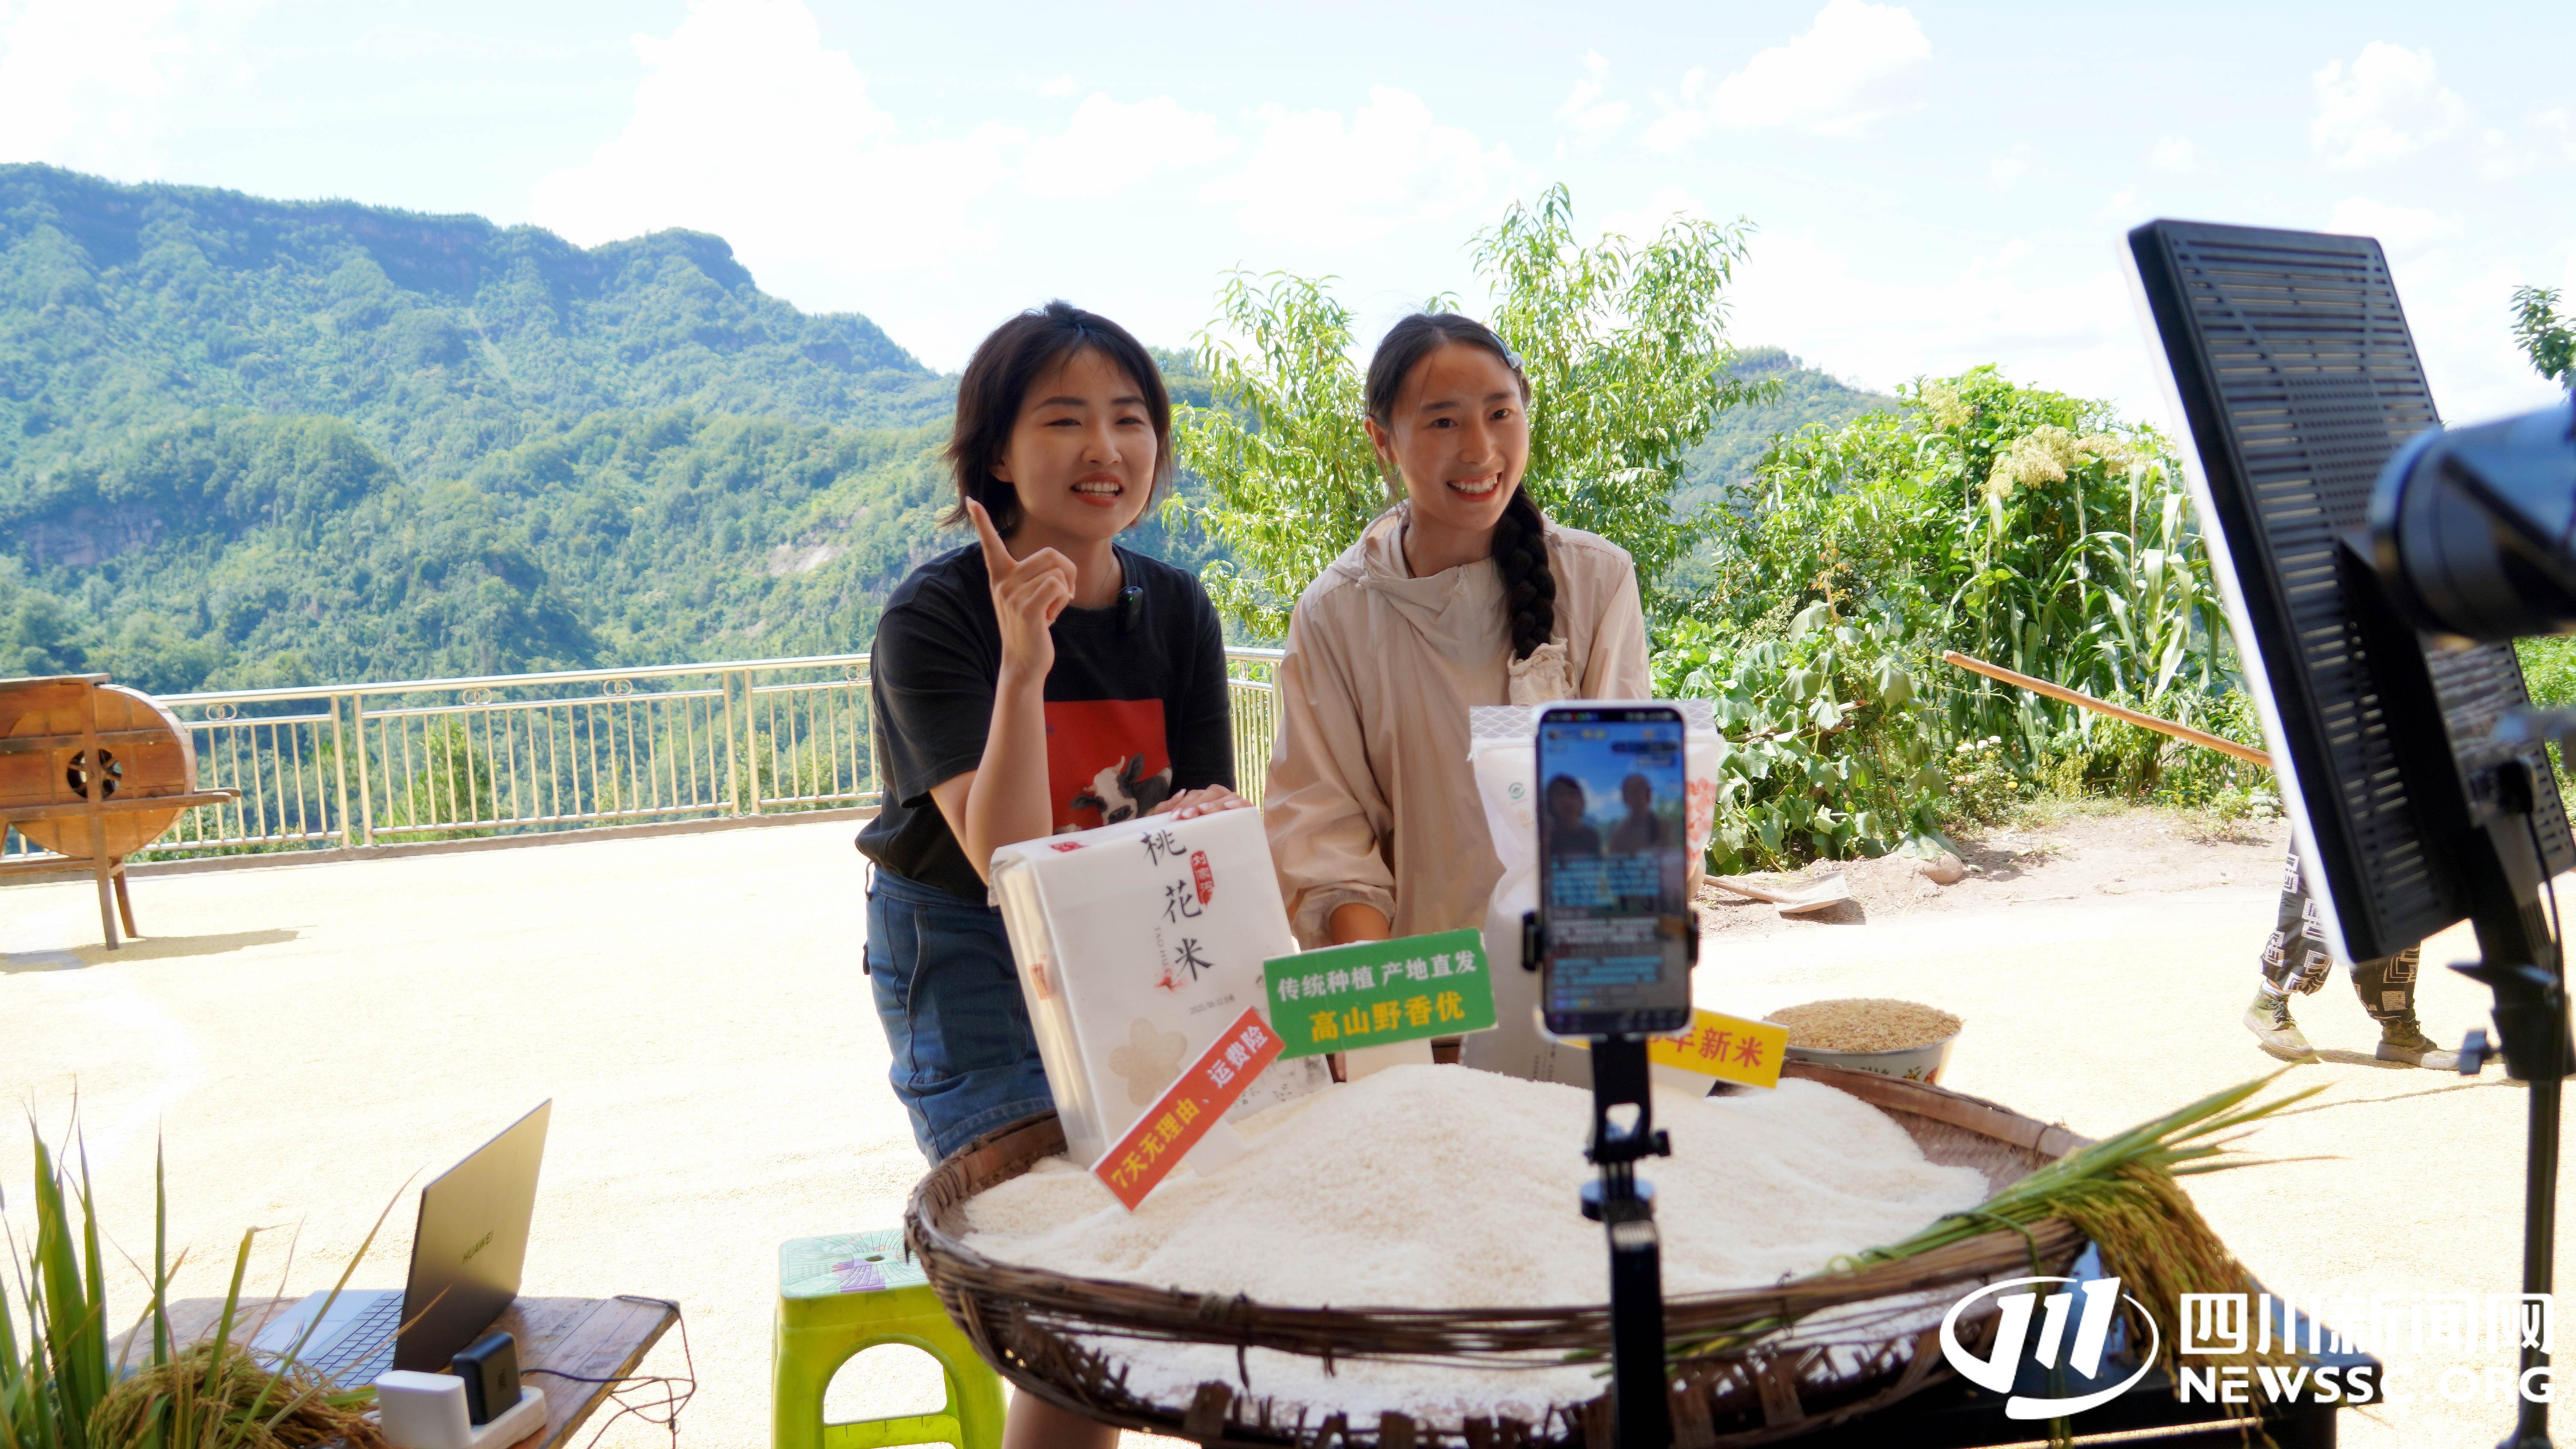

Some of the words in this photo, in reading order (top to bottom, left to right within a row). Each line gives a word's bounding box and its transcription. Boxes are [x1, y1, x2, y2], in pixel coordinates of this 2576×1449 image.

[1140, 830, 1215, 982] 桃花米
[1277, 965, 1376, 1002] 传统种植
[1381, 950, 1476, 986] 产地直发
[1309, 991, 1465, 1043] 高山野香优
[1649, 1026, 1763, 1068] 年新米
[462, 1229, 494, 1265] HUAWEI
